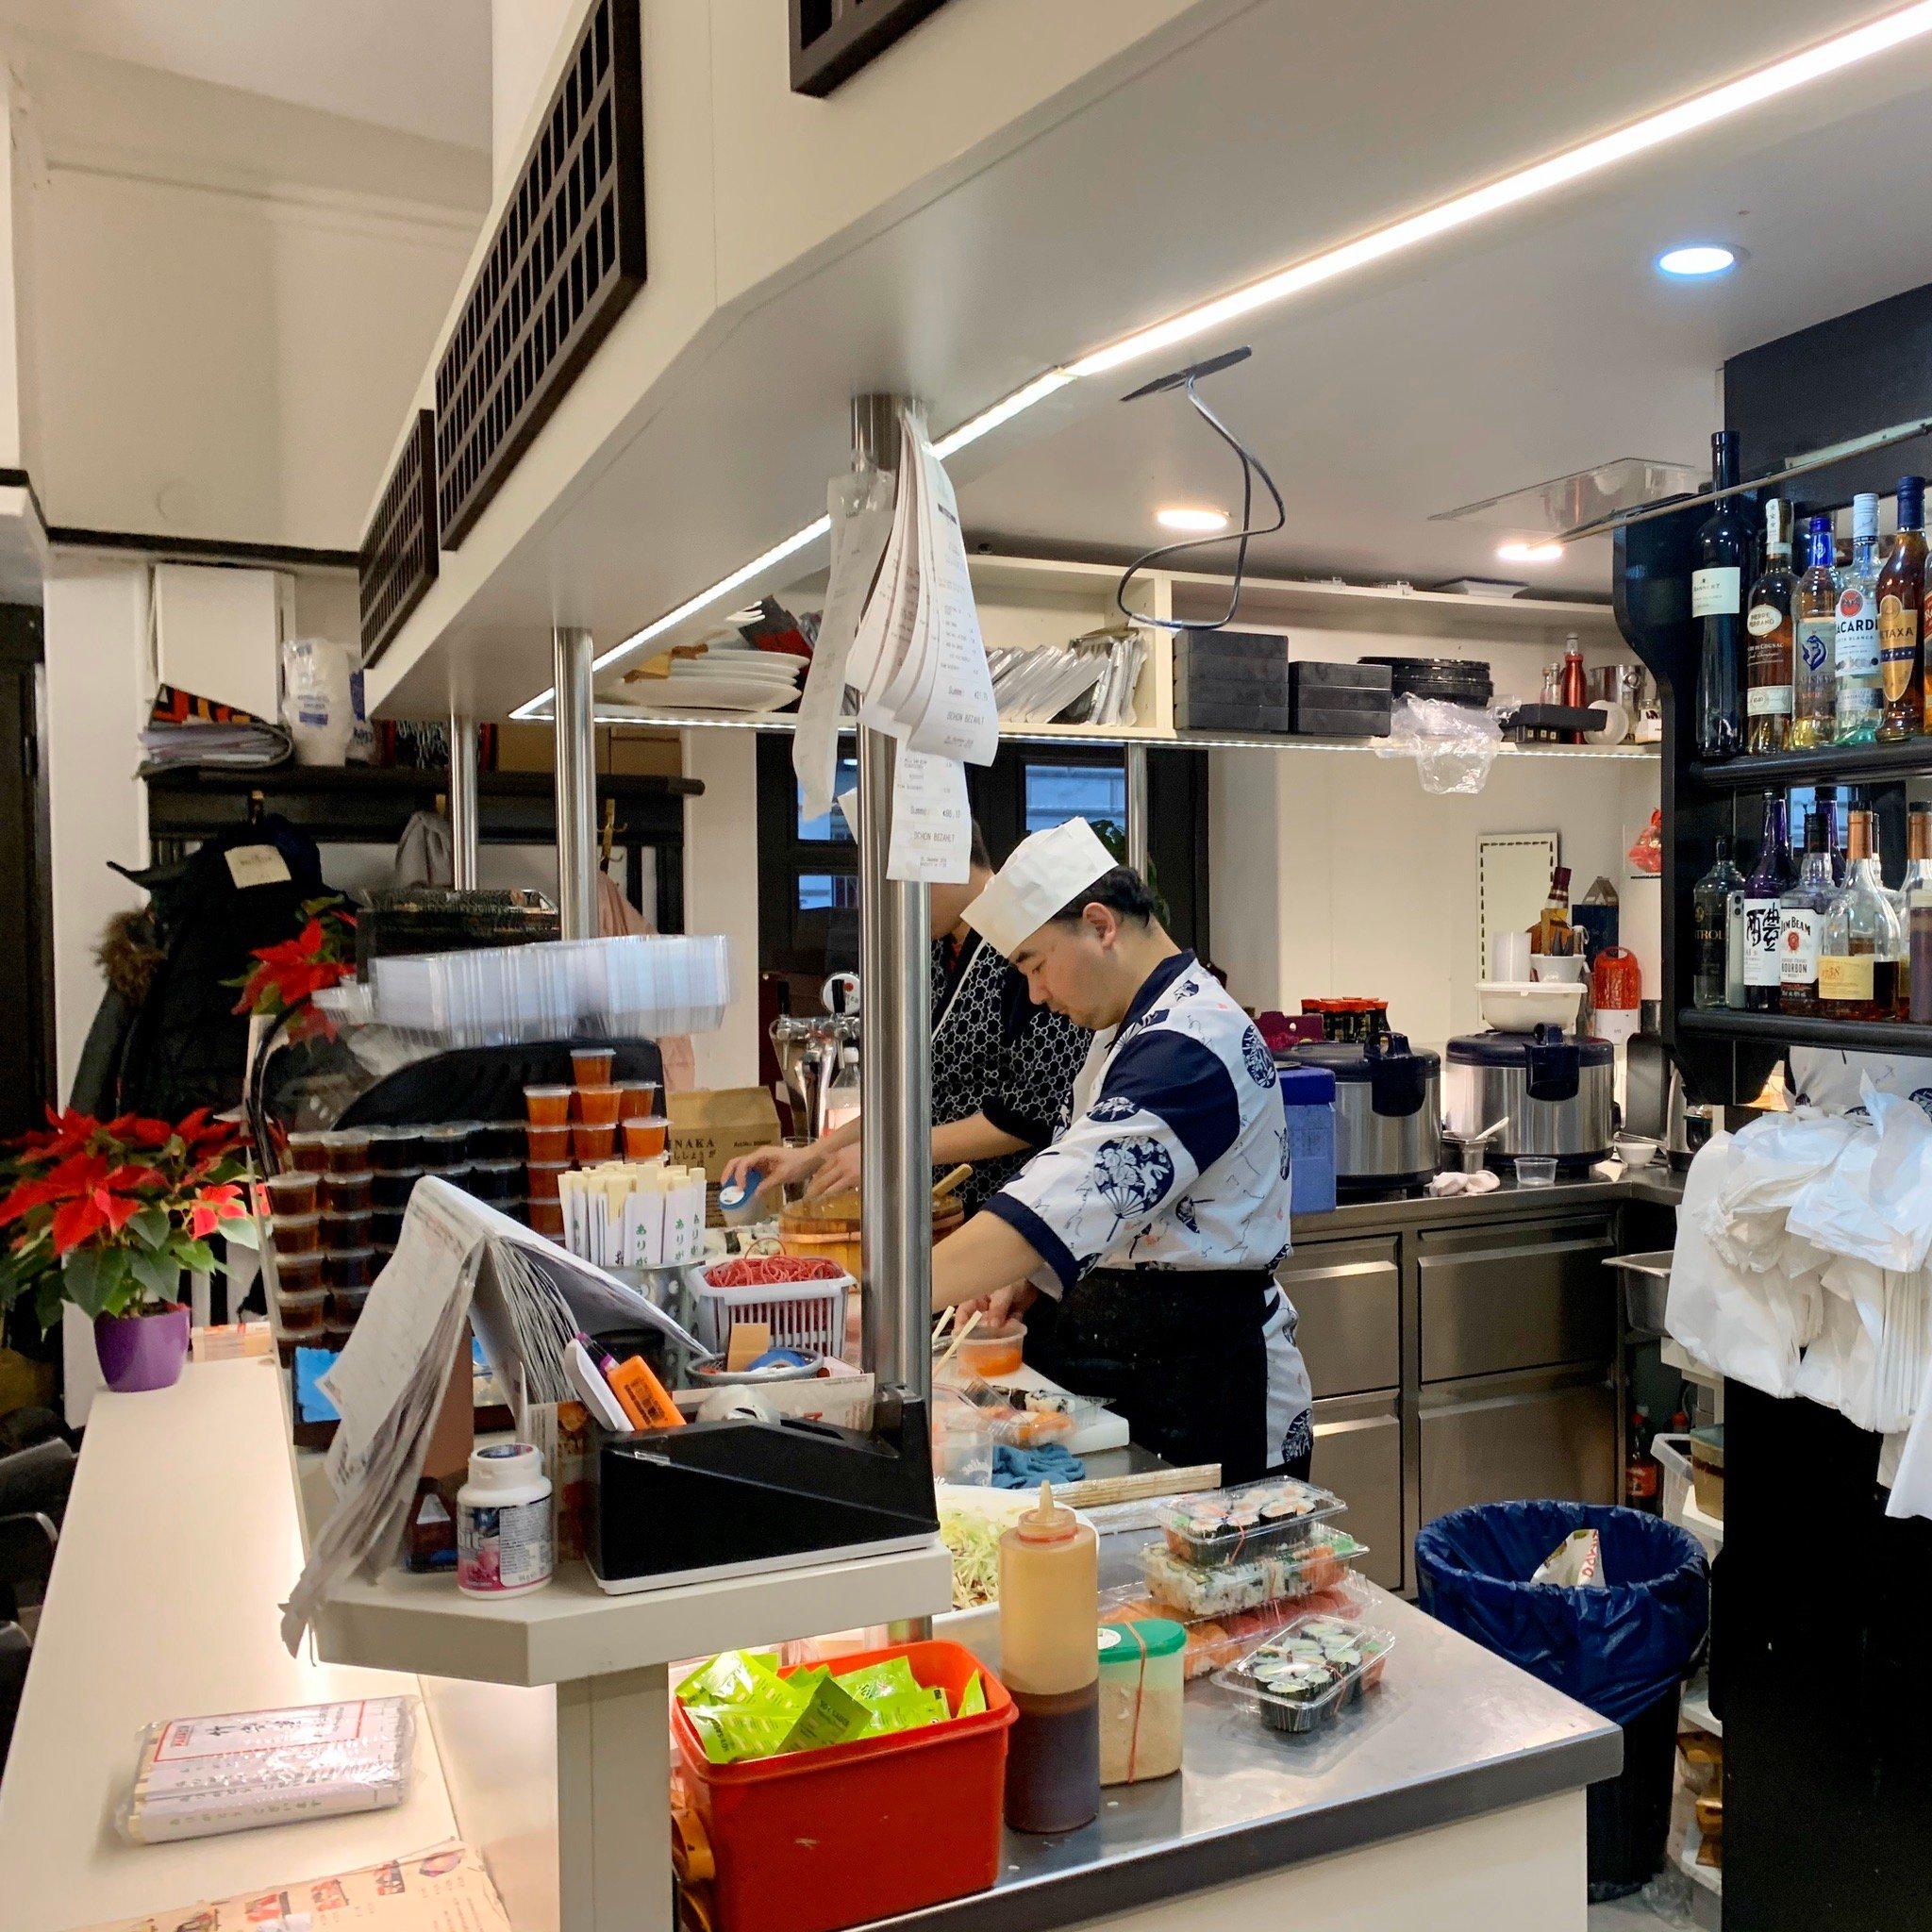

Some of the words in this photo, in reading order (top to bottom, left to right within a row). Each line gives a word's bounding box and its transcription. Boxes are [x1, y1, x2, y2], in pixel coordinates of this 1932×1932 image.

[1836, 618, 1878, 634] ACARDI
[1790, 916, 1811, 936] BEAM
[1781, 962, 1807, 974] BOURBON
